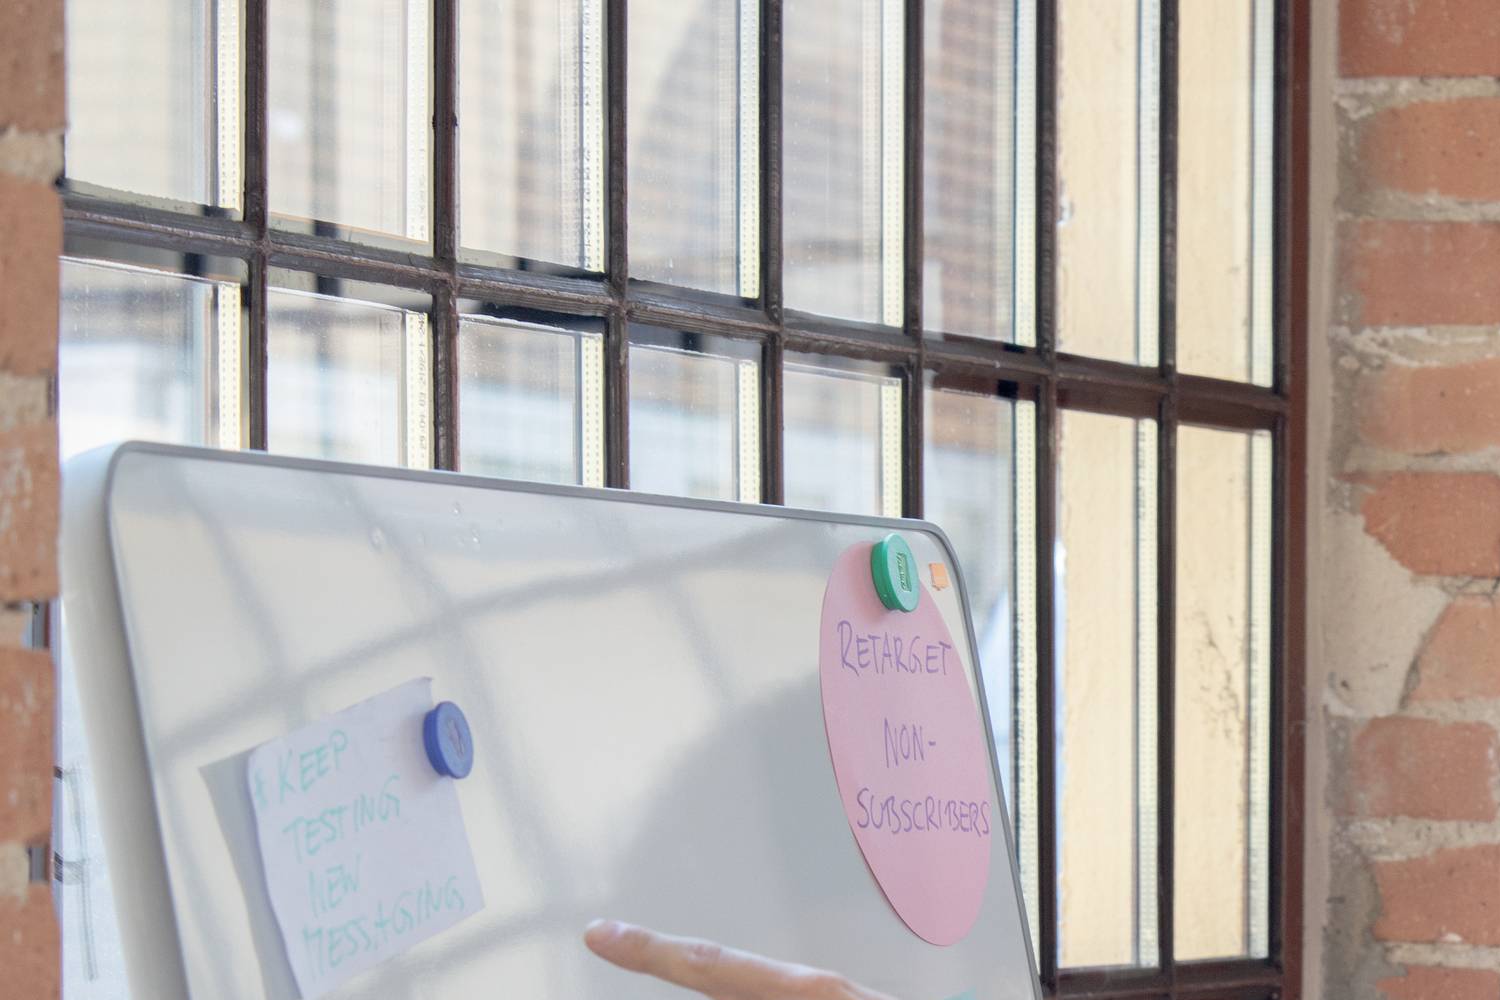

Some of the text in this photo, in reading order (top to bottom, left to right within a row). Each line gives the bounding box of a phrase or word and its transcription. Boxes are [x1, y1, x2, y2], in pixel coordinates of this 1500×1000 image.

[837, 619, 951, 676] RETARGET
[276, 729, 348, 802] KEEP
[883, 717, 937, 768] NON-
[282, 774, 401, 862] TESTING
[855, 787, 990, 837] SUBSCRIBERS
[308, 853, 362, 918] NEW
